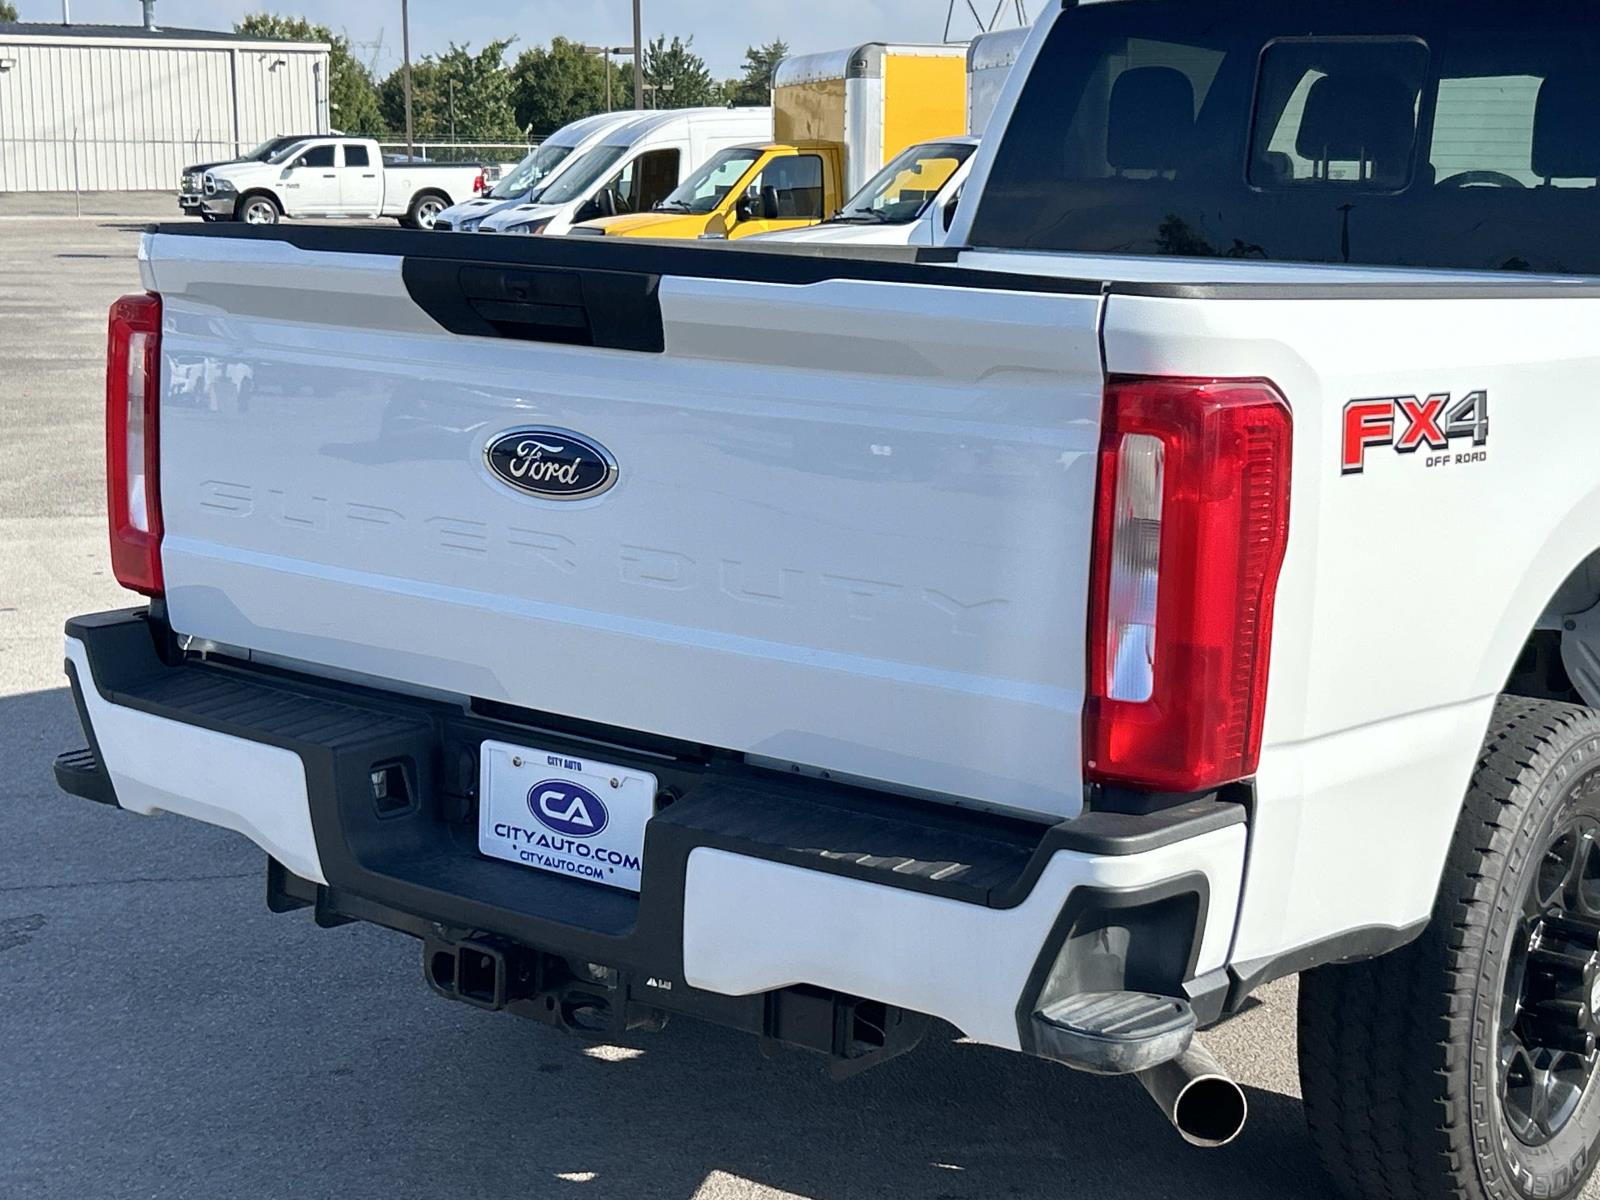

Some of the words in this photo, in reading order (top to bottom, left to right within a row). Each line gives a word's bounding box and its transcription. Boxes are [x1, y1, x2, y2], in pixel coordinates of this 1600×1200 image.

[1341, 389, 1489, 476] FX4
[509, 440, 581, 485] Ford
[1426, 454, 1451, 468] OFF
[1455, 451, 1487, 465] ROAD
[198, 479, 577, 575] SUPER
[619, 543, 1010, 637] DUTY
[547, 756, 563, 767] CITY
[564, 759, 582, 771] AUTO
[539, 790, 594, 827] CA
[494, 823, 641, 871] CITYAUTO.COM
[519, 850, 604, 879] CITYAUTO.COM
